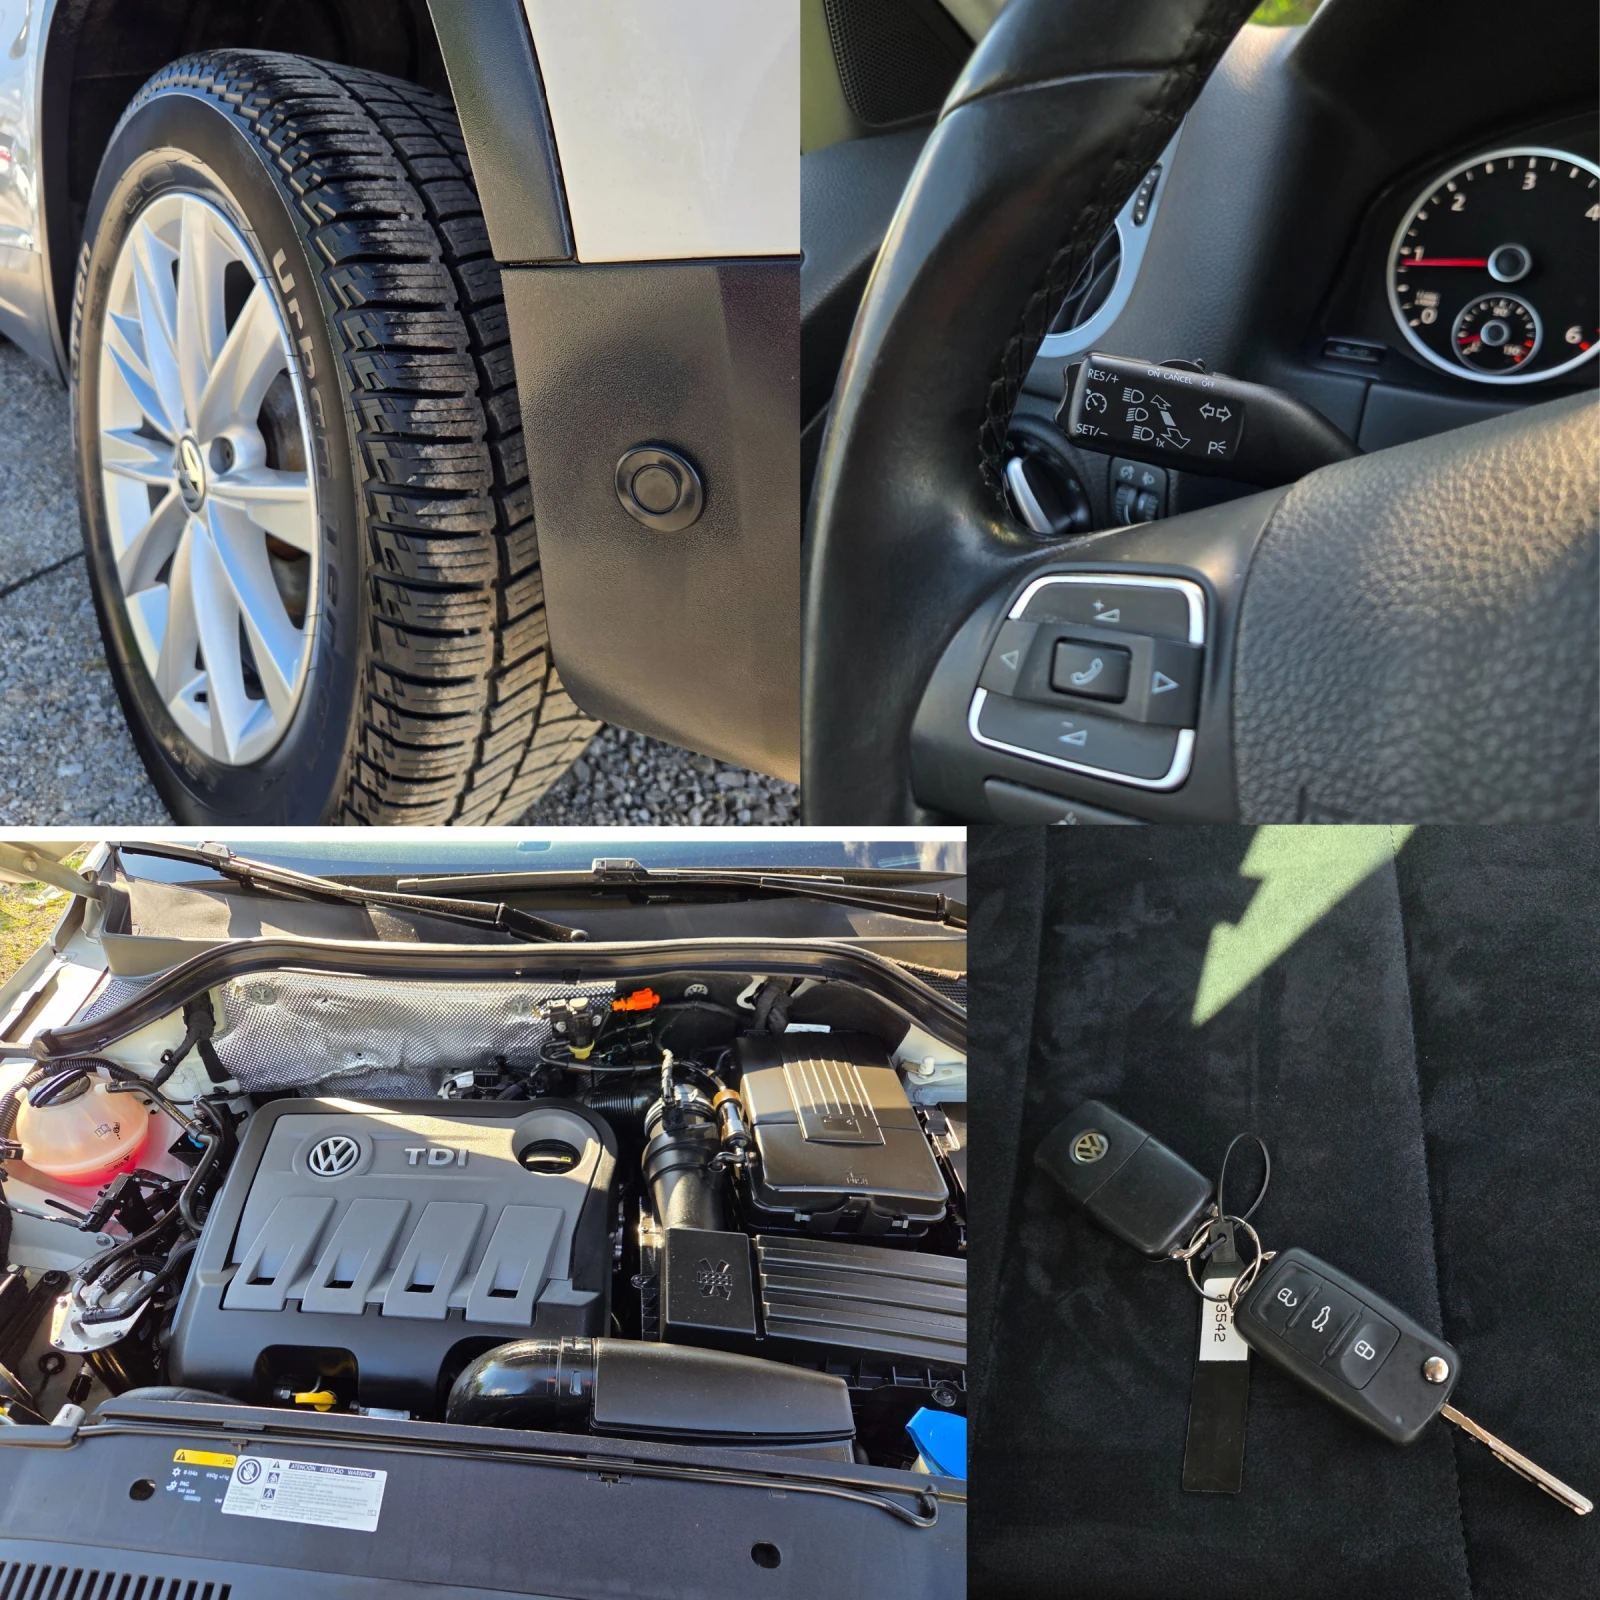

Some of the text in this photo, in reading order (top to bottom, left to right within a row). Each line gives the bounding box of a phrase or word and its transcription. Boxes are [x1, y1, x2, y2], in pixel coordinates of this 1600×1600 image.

[1522, 171, 1537, 190] 3
[1451, 192, 1466, 212] 2
[1564, 325, 1583, 344] 6
[272, 248, 332, 480] Urban
[1087, 368, 1120, 384] RES/+
[1147, 369, 1216, 388] ON CANCEL OFF
[1155, 437, 1166, 449] 1x
[404, 1147, 469, 1169] TDI
[347, 1470, 373, 1478] WARNING
